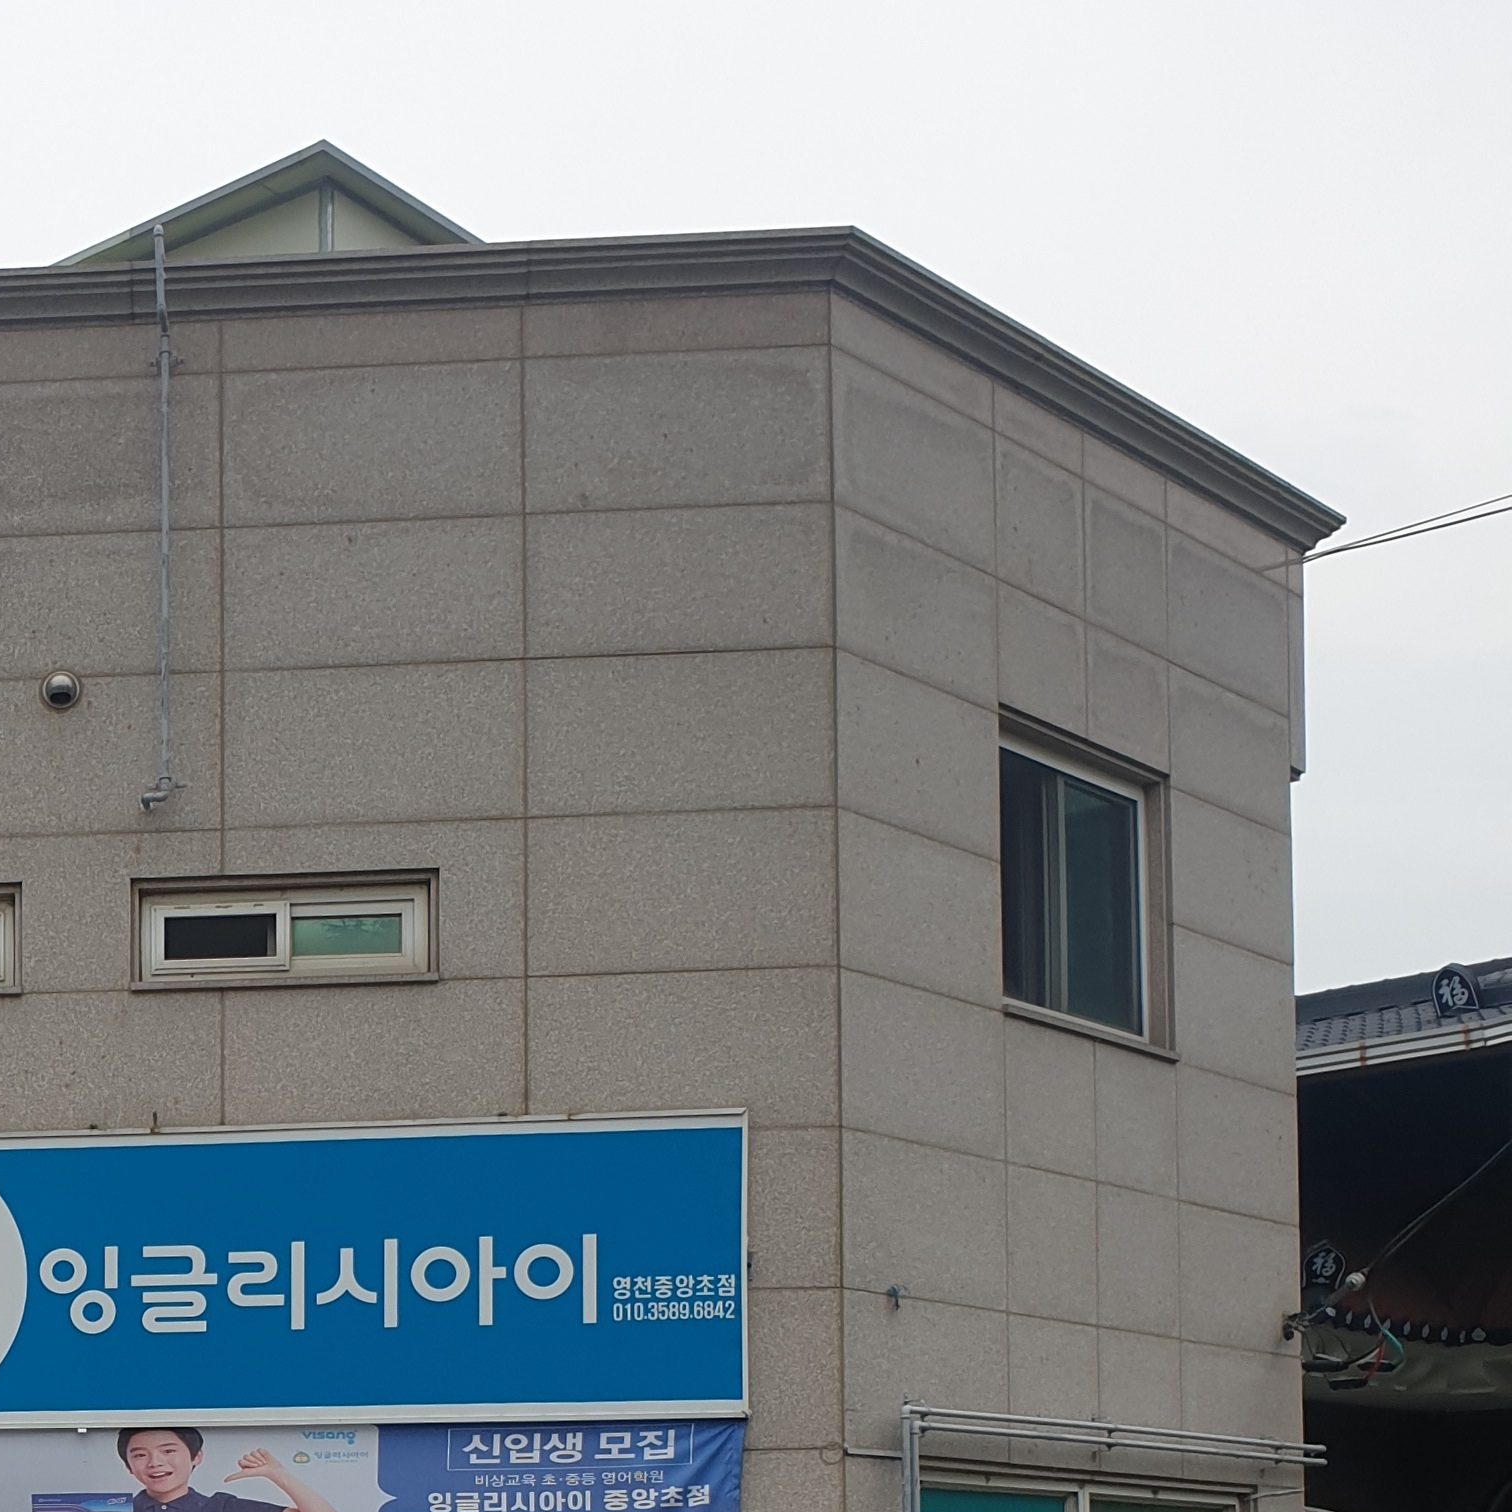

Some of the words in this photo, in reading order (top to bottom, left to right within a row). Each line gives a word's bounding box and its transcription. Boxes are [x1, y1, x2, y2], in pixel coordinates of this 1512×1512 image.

[39, 1233, 598, 1335] 잉글리시아이
[612, 1274, 736, 1299] 영천중앙초점
[613, 1300, 736, 1321] 010.3589.6842
[302, 1430, 357, 1445] visang
[462, 1432, 583, 1464] 신입생
[594, 1429, 676, 1460] 모집
[475, 1473, 536, 1487] 비상교육
[601, 1470, 664, 1484] 영어학원
[603, 1484, 710, 1511] 중앙초점
